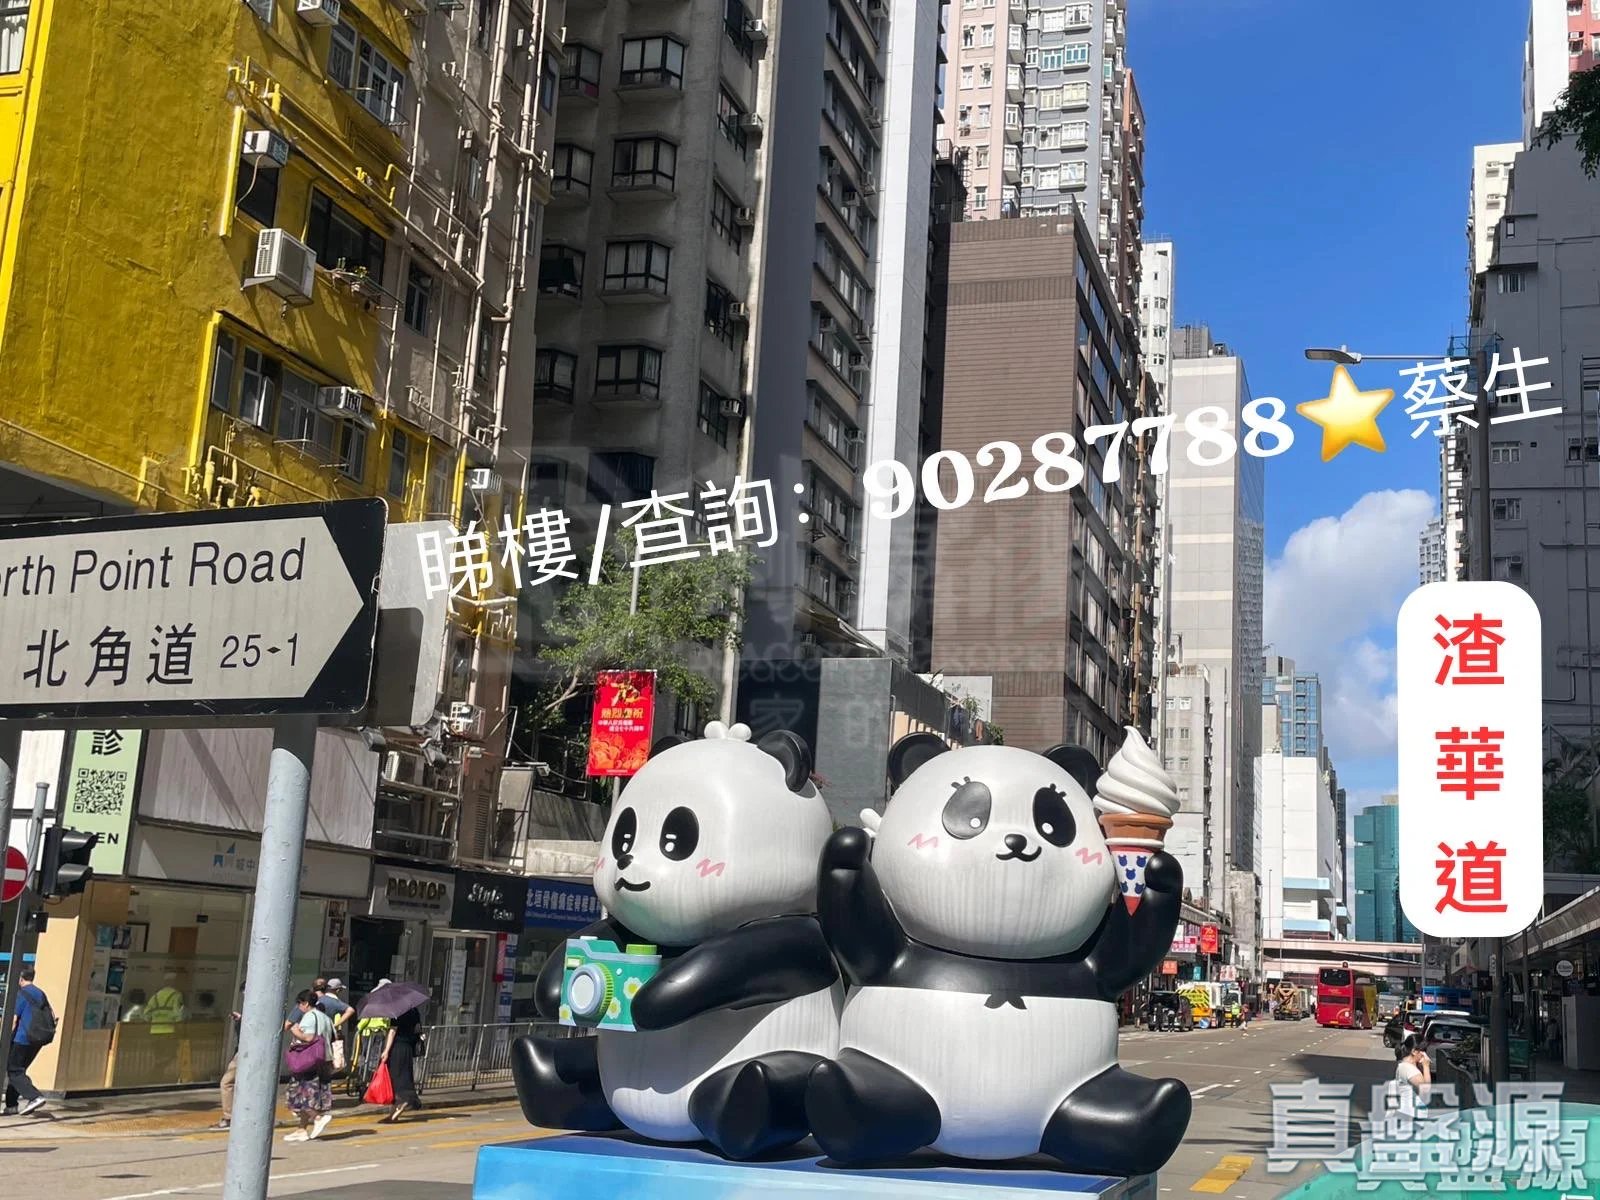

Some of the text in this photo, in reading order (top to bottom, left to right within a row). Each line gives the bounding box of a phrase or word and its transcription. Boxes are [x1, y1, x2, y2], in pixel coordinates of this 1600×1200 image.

[0, 537, 306, 597] rth Point Road
[23, 622, 197, 688] 北角道
